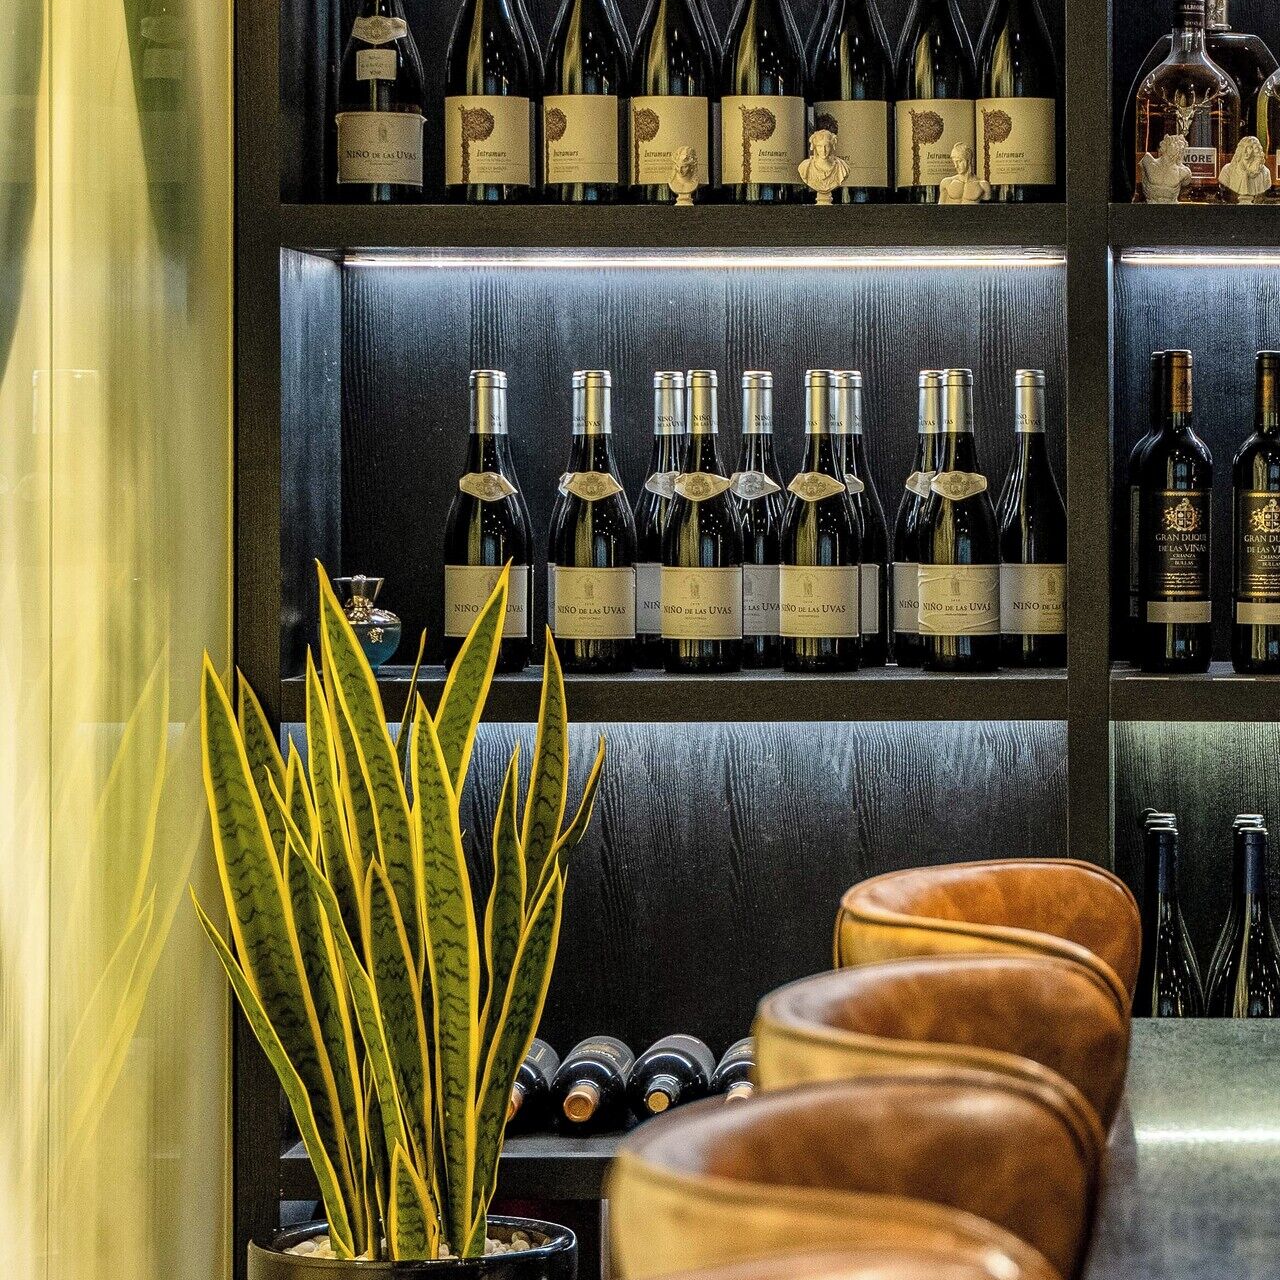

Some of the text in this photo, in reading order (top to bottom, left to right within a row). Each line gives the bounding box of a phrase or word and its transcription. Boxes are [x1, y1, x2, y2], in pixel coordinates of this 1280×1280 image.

[347, 150, 369, 158] NIÑO
[397, 150, 416, 160] UVAS
[1182, 534, 1207, 542] DUQUE
[1244, 534, 1267, 543] GRAN
[454, 603, 479, 613] NIÑO
[558, 604, 577, 614] NIÑO
[603, 605, 626, 615] UVAS
[664, 604, 682, 614] NIÑO
[709, 606, 732, 615] UVAS
[781, 603, 796, 612] NIÑO
[822, 604, 846, 613] UVAS
[923, 602, 943, 611] NIÑO
[969, 602, 991, 611] UVAS
[1013, 601, 1039, 610] NIÑO
